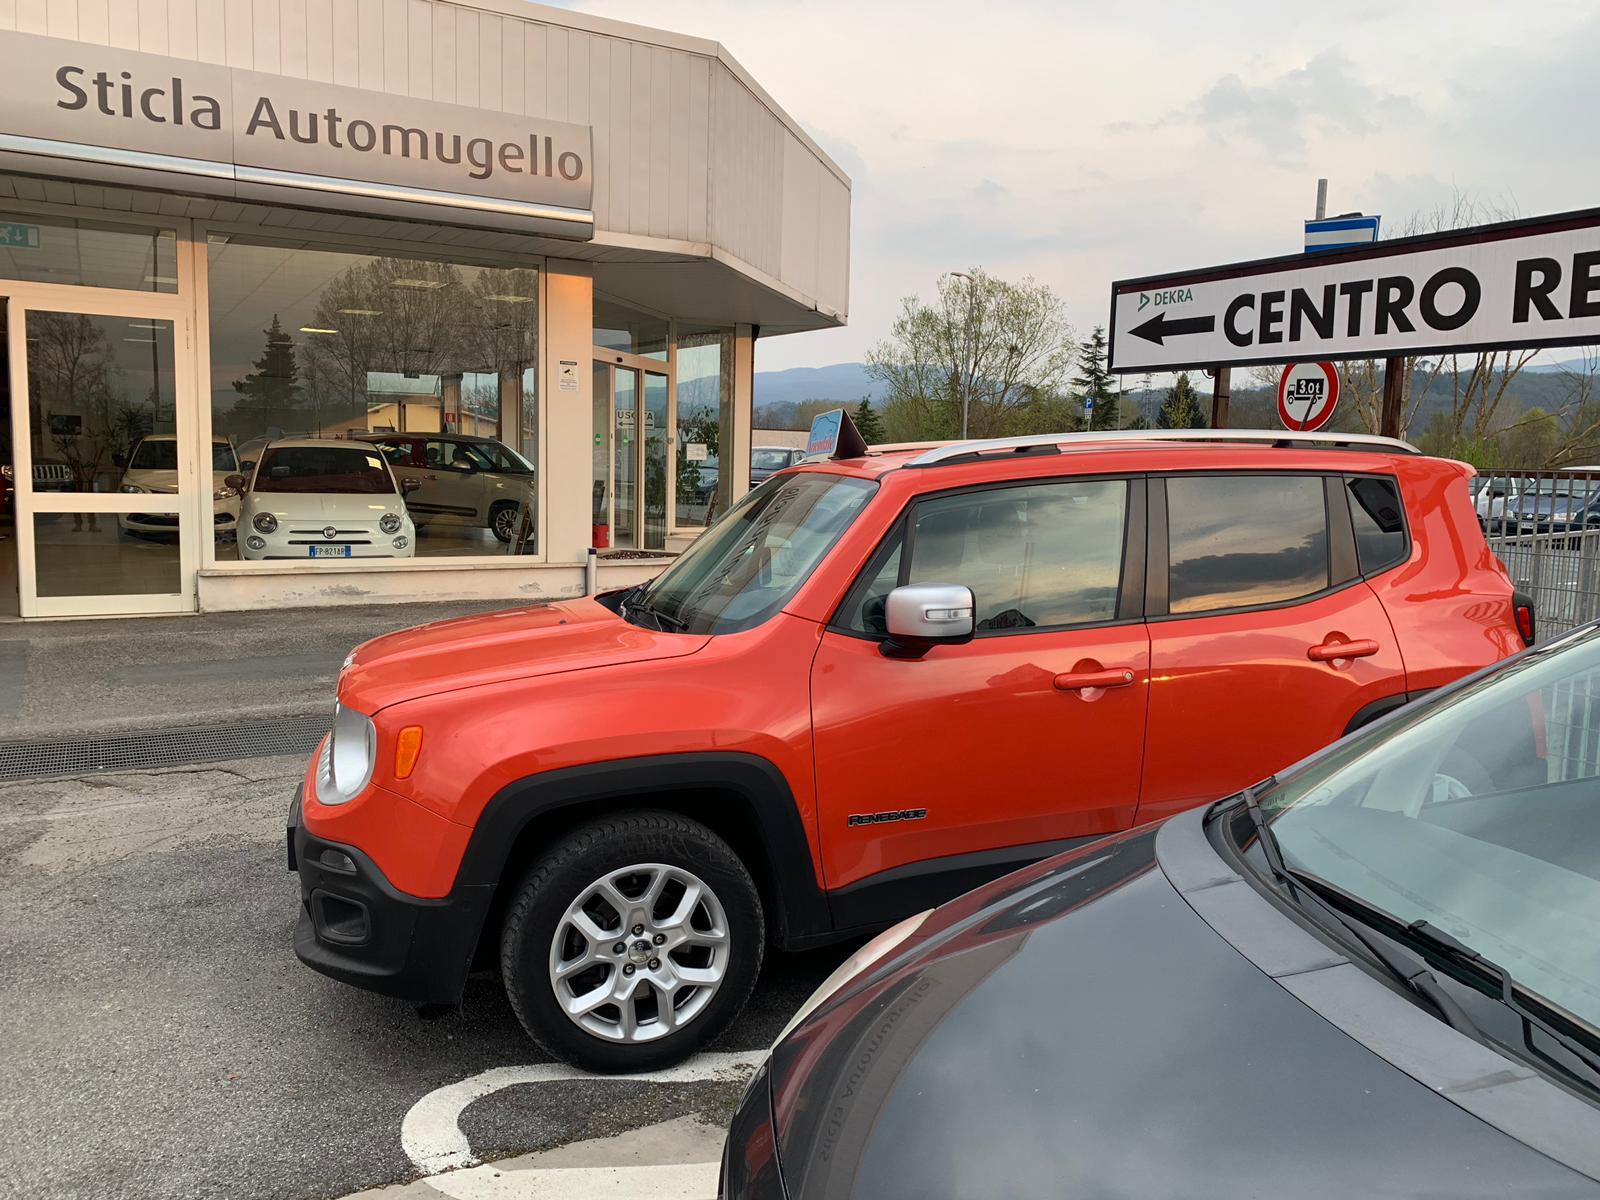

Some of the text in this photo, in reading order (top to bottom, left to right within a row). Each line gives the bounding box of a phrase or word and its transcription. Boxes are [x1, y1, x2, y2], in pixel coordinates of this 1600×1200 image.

[56, 65, 584, 181] Sticla Automugello
[1154, 288, 1193, 306] DEKRA
[1223, 266, 1482, 348] CENTRO
[848, 808, 928, 827] RENEGADE
